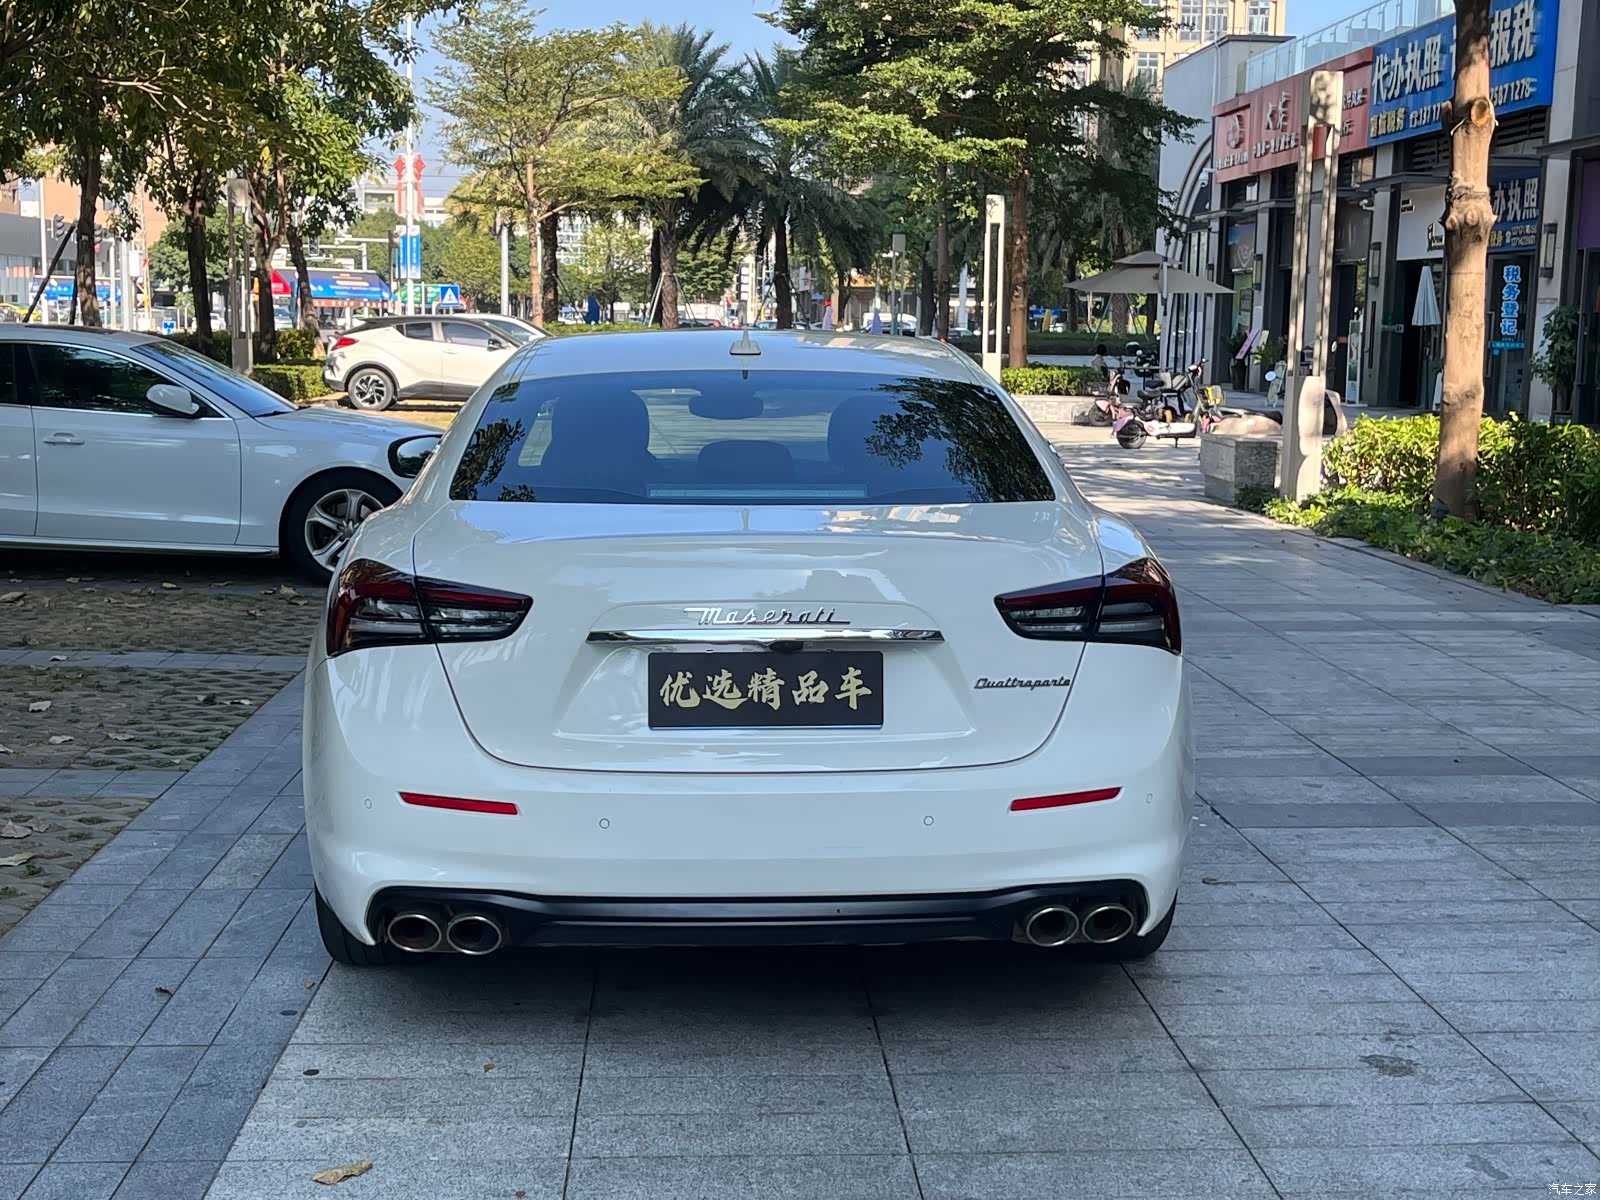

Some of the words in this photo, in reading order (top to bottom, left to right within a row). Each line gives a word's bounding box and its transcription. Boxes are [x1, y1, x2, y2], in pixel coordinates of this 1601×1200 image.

[1372, 34, 1442, 104] 代办执照
[1493, 177, 1539, 222] 办执照
[1502, 265, 1522, 335] 税务登记
[683, 606, 851, 625] Maserati
[659, 666, 873, 711] 优选精品车
